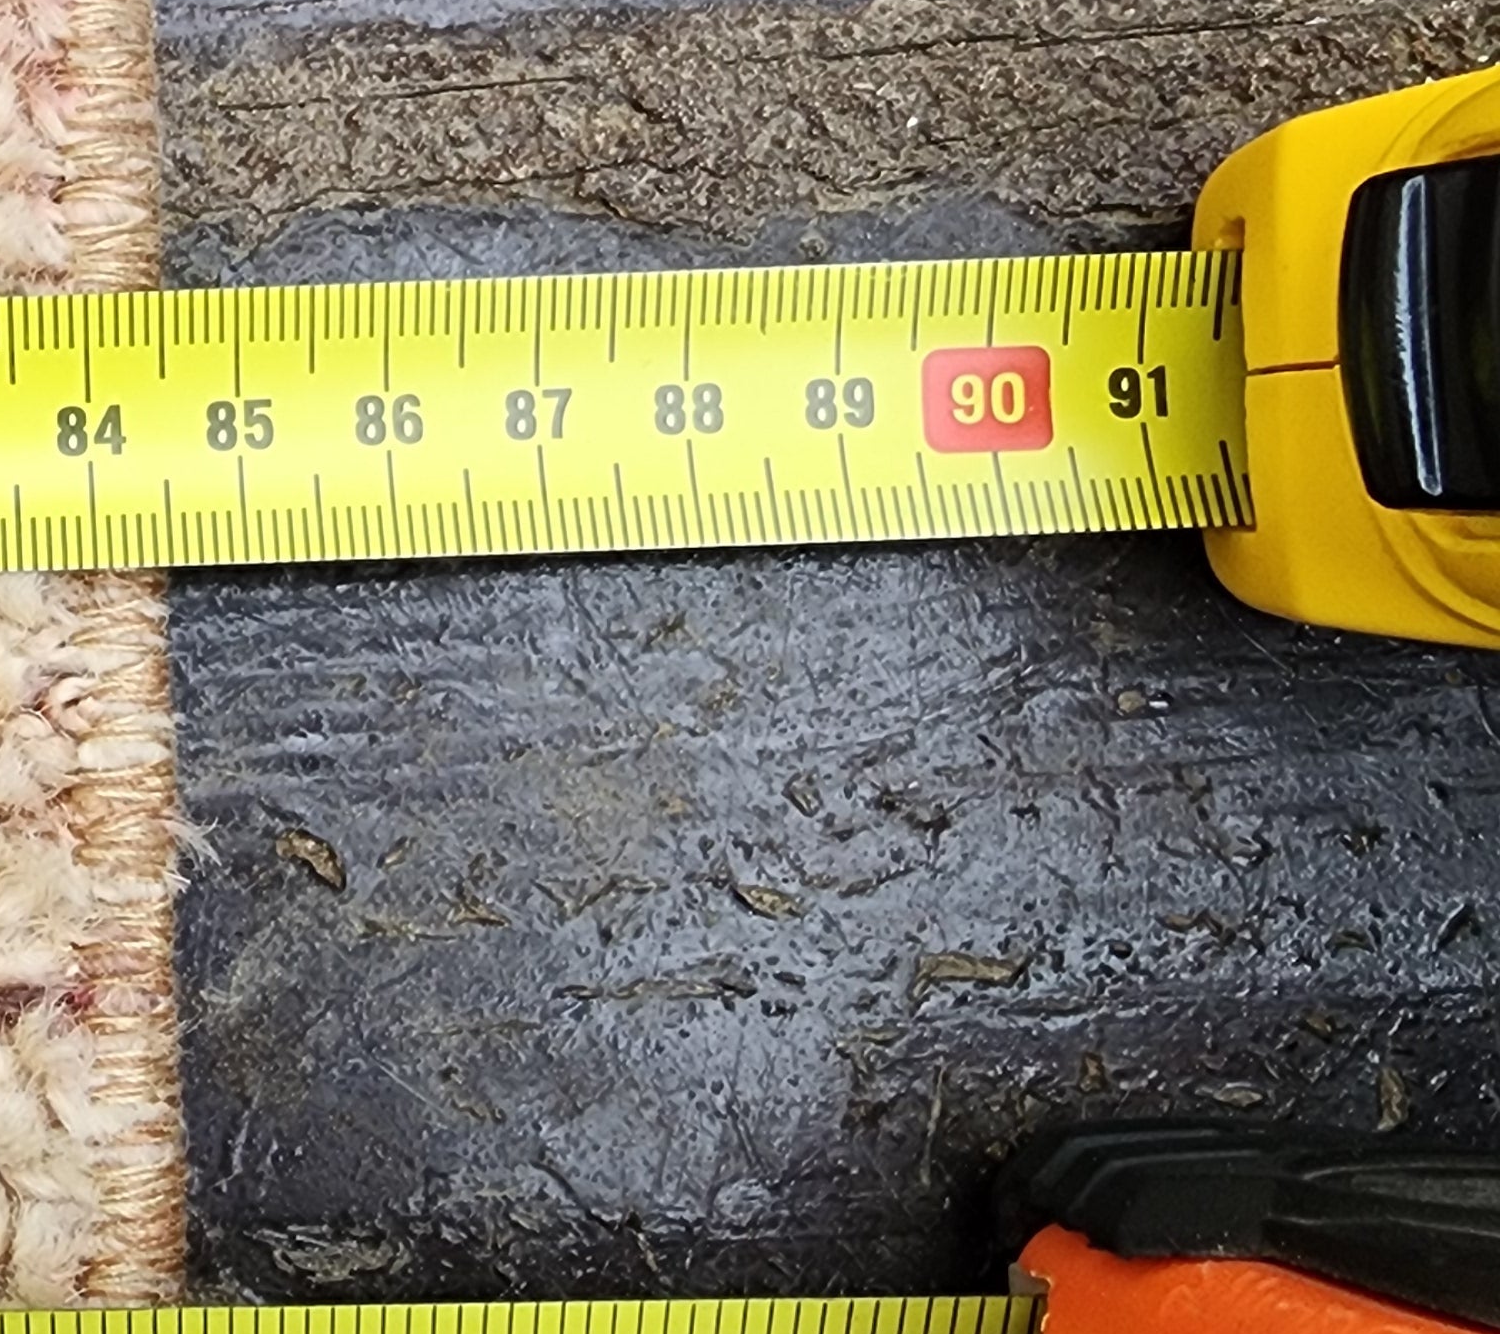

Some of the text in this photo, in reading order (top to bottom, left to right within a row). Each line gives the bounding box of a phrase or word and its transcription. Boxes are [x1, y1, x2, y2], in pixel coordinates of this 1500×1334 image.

[56, 405, 126, 456] 84
[206, 399, 274, 451] 85
[355, 395, 424, 445] 86
[505, 389, 572, 439] 87
[654, 384, 724, 434] 88
[805, 377, 874, 428] 89
[951, 373, 1025, 424] 90
[1108, 366, 1169, 418] 91
